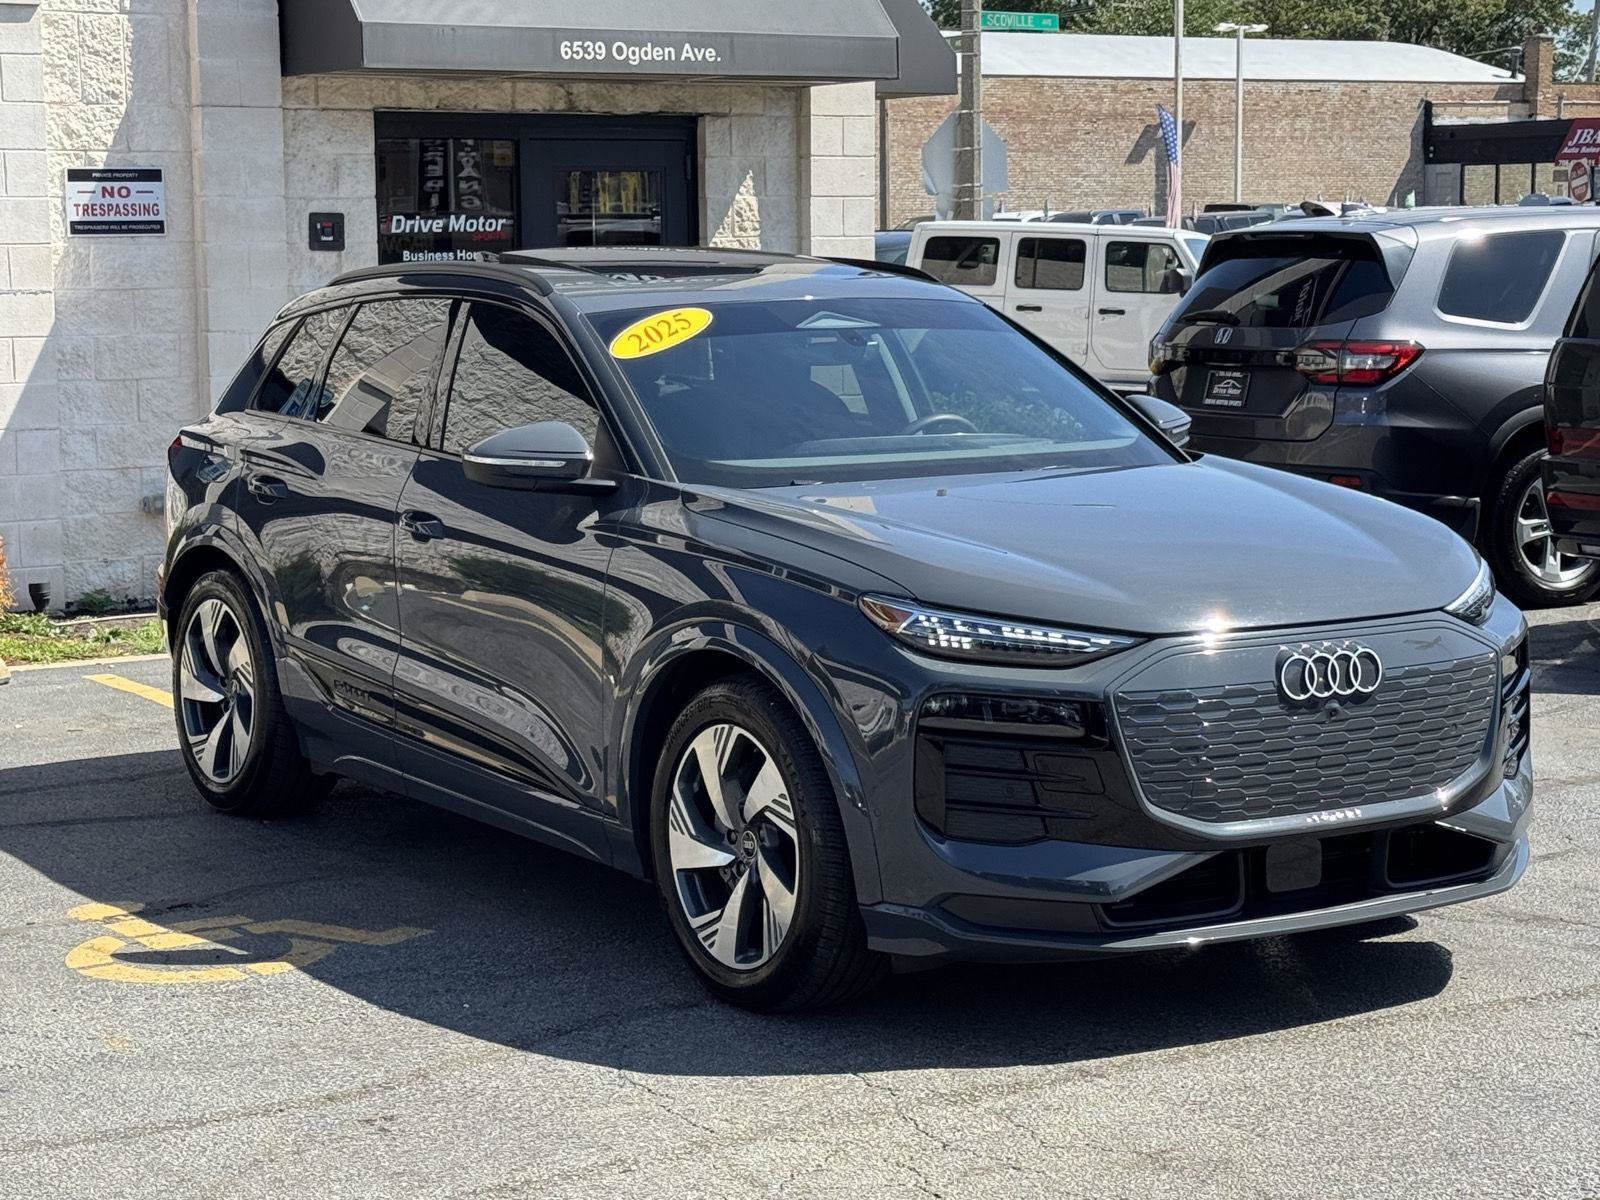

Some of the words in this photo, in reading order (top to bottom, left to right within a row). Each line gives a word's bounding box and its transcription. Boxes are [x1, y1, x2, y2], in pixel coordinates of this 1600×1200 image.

[987, 14, 1034, 27] SCOVILLE
[560, 41, 606, 60] 6539
[612, 41, 676, 66] Ogden
[680, 43, 722, 62] Ave.
[101, 185, 131, 199] NO
[73, 203, 160, 217] TRESPASSING
[448, 214, 507, 233] Motor
[402, 250, 454, 262] Business
[627, 312, 692, 353] 2025
